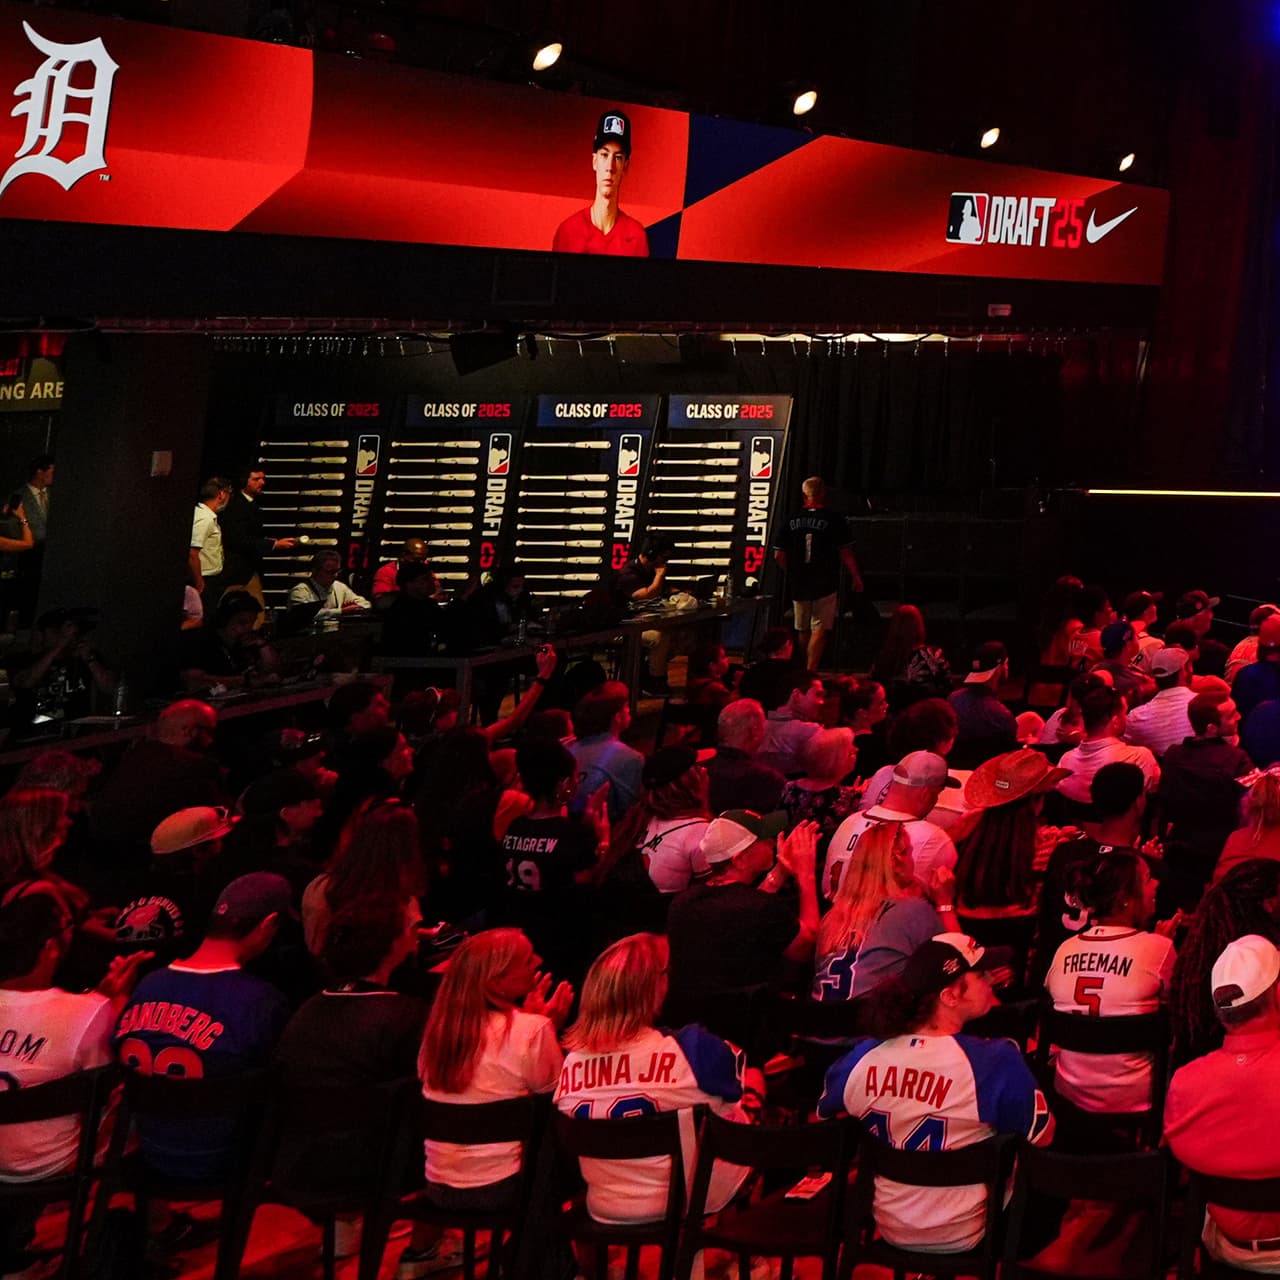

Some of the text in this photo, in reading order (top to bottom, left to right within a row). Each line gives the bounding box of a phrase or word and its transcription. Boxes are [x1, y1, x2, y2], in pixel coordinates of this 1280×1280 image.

[988, 196, 1085, 249] DRAFT 25
[293, 402, 380, 417] CLASS OF 2025
[424, 402, 512, 418] CLASS OF 2025
[555, 403, 642, 418] CLASS OF 2025
[686, 404, 774, 419] CLASS OF 2025
[613, 479, 637, 542] DRAFT
[744, 482, 770, 573] DRAFT 25
[1064, 953, 1133, 977] FREEMAN
[1074, 976, 1104, 1017] 5
[116, 1002, 224, 1051] SANDBERG
[639, 1052, 677, 1084] JR.
[866, 1066, 953, 1109] AARON
